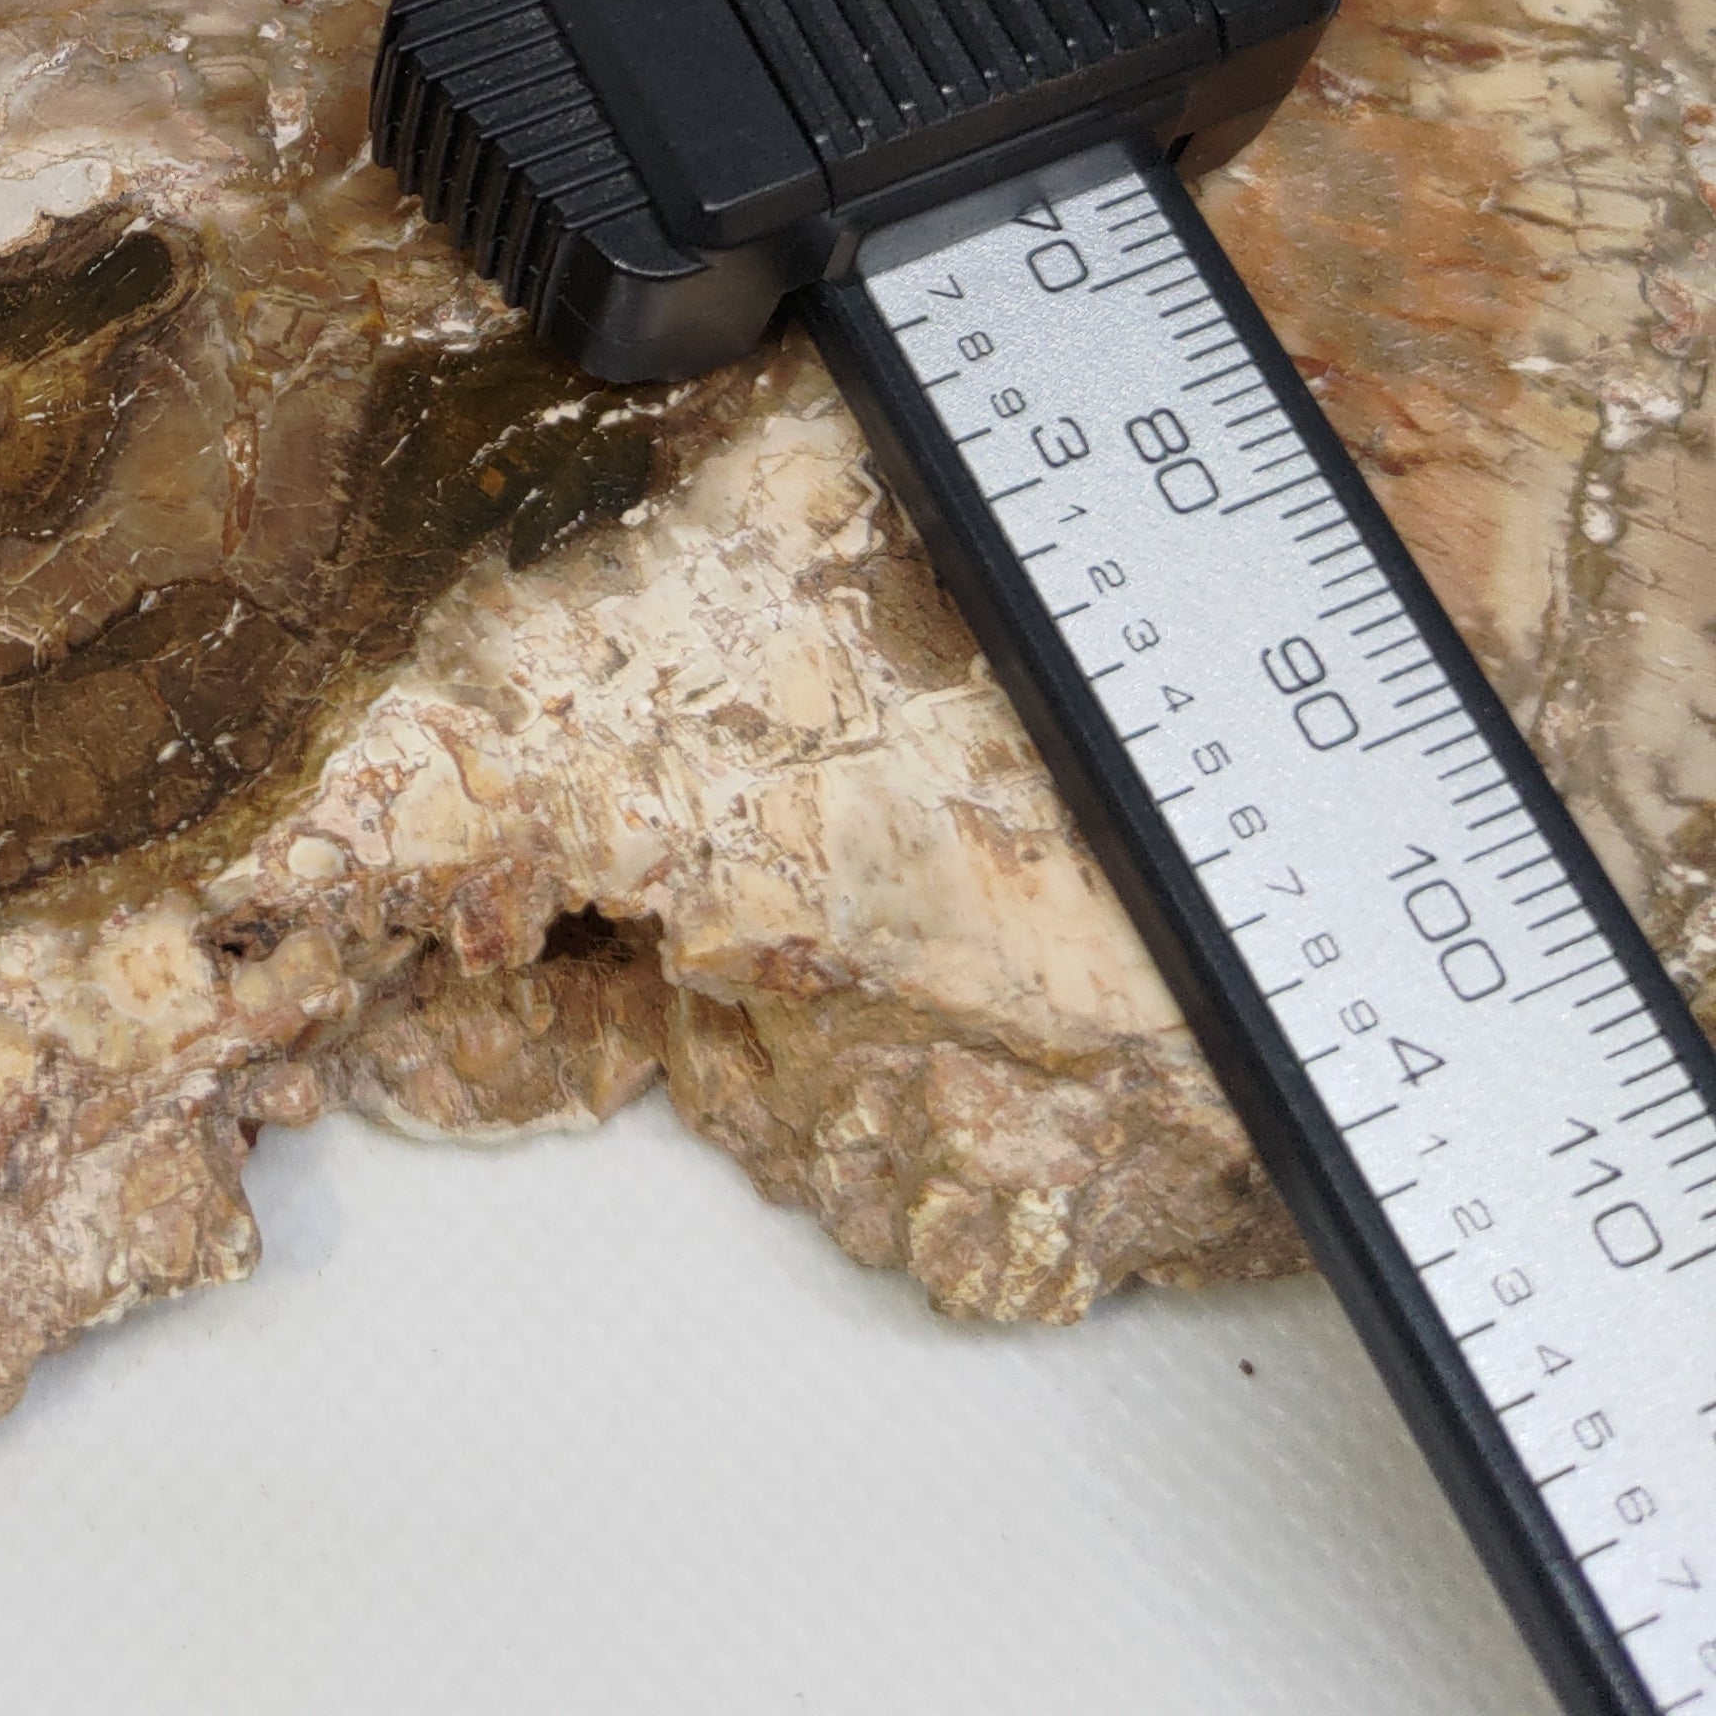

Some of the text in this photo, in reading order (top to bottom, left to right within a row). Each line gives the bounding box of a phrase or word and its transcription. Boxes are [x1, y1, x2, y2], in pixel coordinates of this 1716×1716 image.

[927, 272, 964, 301] 7
[957, 330, 995, 362] 8
[989, 386, 1027, 419] 9
[1030, 416, 1091, 469] 3
[1087, 559, 1127, 595] 2
[1122, 618, 1160, 653] 3
[1159, 684, 1195, 713] 4
[1190, 740, 1233, 776] 5
[1228, 804, 1268, 840] 6
[1265, 865, 1306, 897] 7
[1301, 931, 1340, 969] 8
[1388, 1036, 1446, 1086] 4
[1451, 1198, 1495, 1239] 2
[1491, 1267, 1534, 1307] 3
[1535, 1343, 1574, 1377] 4
[1572, 1410, 1614, 1451] 5
[1008, 197, 1664, 1269] 70 80 90 100 110
